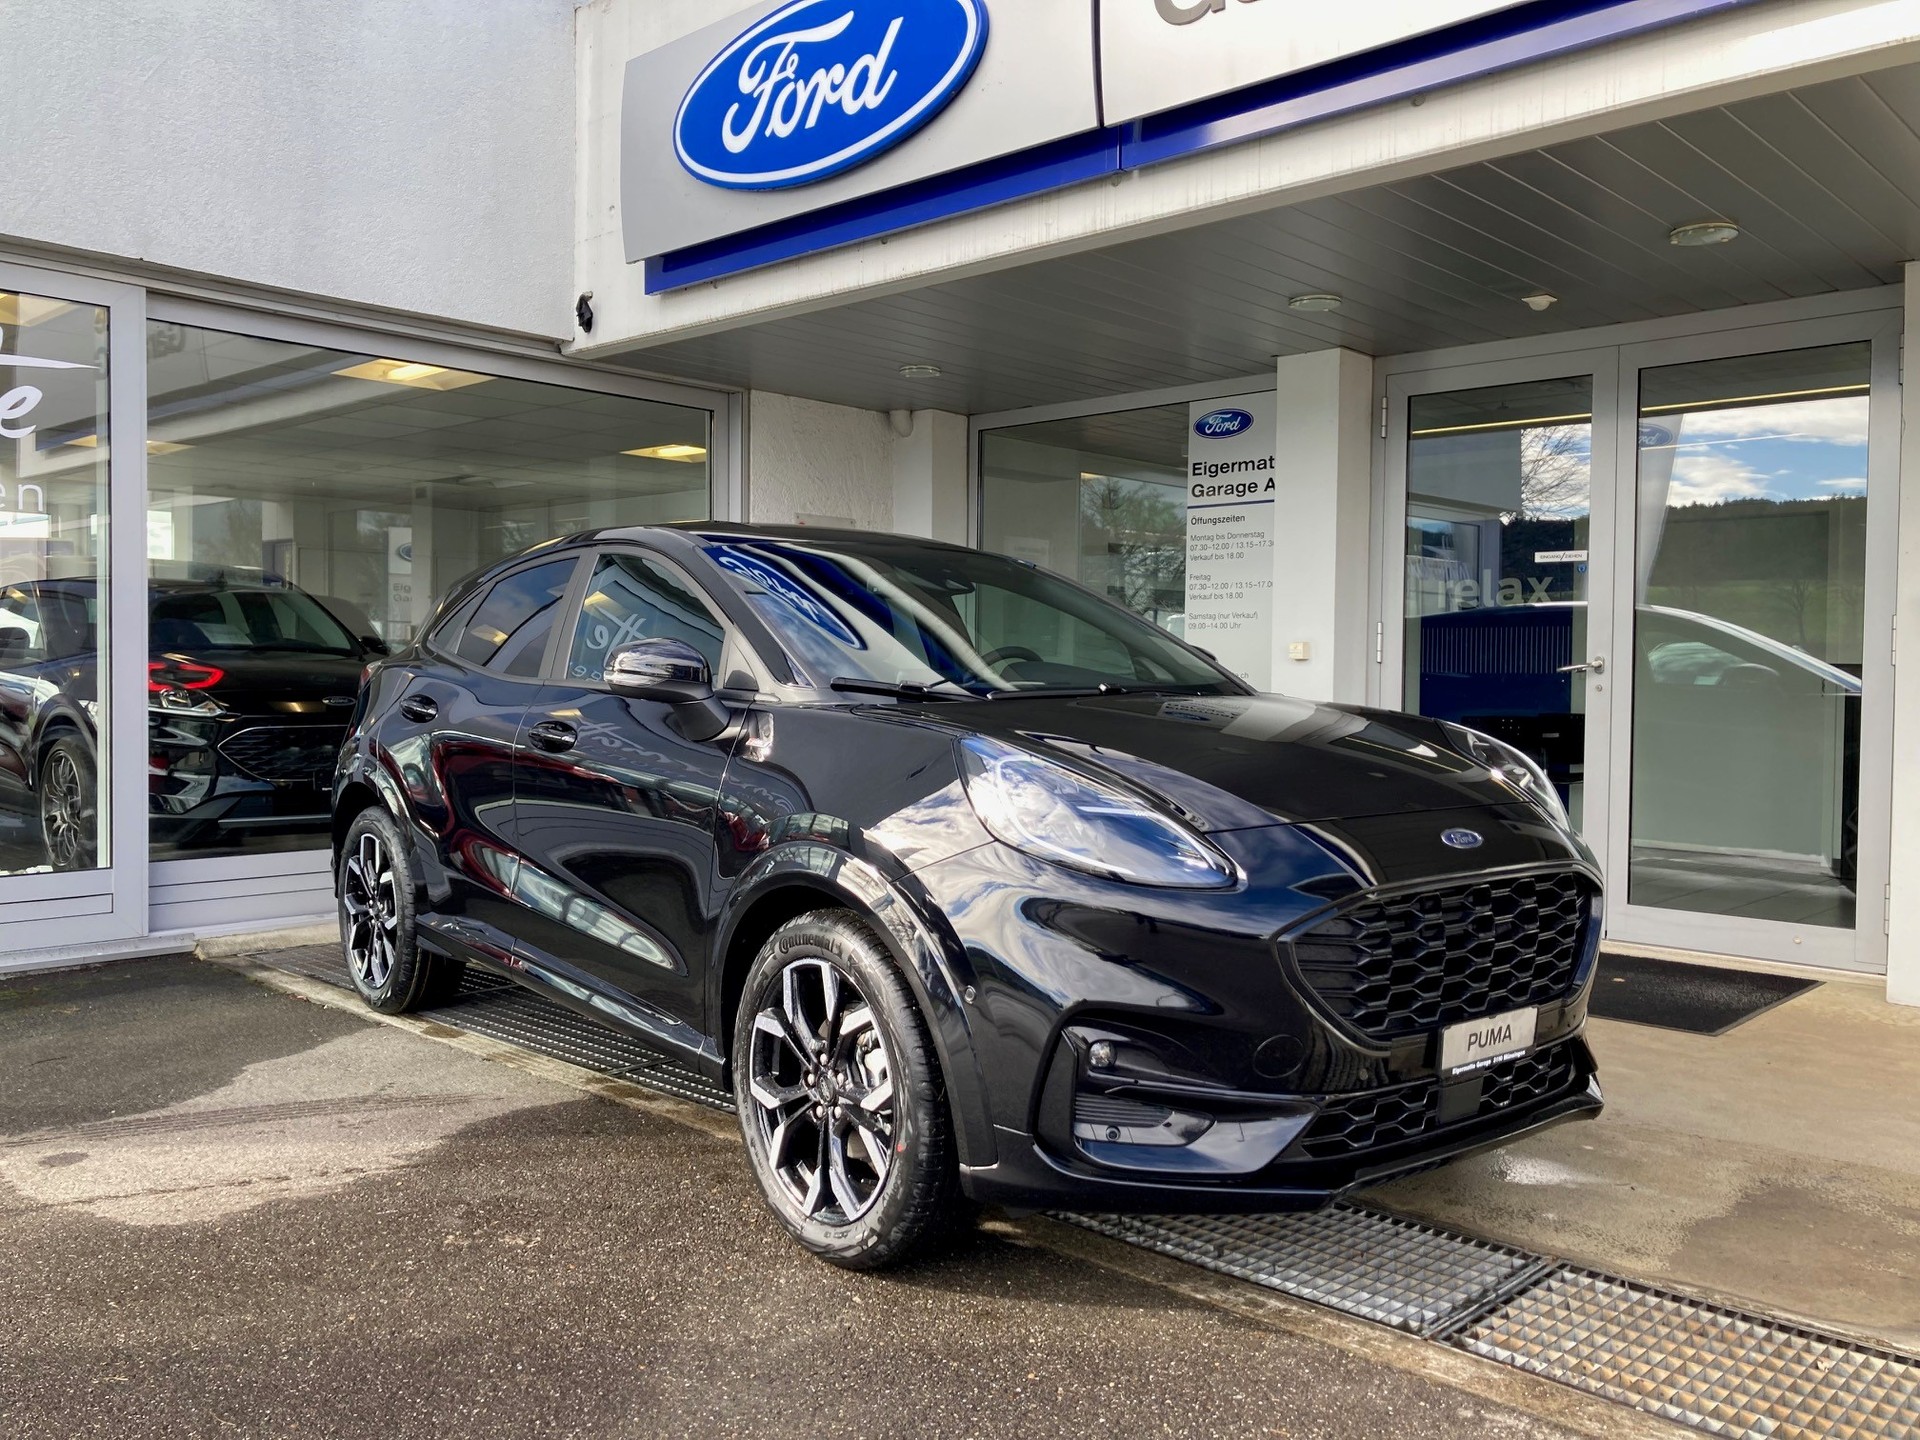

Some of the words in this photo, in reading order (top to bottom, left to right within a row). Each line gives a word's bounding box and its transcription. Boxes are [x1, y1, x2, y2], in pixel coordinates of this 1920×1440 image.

[722, 10, 904, 153] Ford
[1205, 413, 1241, 434] Ford
[1192, 455, 1275, 478] Eigermat
[1191, 481, 1258, 498] Garage
[1190, 534, 1214, 542] Montag
[1227, 531, 1265, 539] Donnerstag
[1189, 553, 1214, 561] Verkauf
[1226, 551, 1245, 559] 18.00
[1189, 573, 1211, 581] Freitag
[1235, 580, 1273, 589] 13.15-17.0
[1438, 569, 1553, 610] relax
[1188, 592, 1213, 600] Verkauf
[1213, 592, 1224, 600] bis
[1225, 591, 1244, 599] 18.00
[1188, 612, 1216, 621] Samstag
[1218, 612, 1231, 620] (nur
[1231, 611, 1258, 620] Verkauf)
[1229, 621, 1241, 629] Uhr
[1467, 1024, 1512, 1052] PUMA
